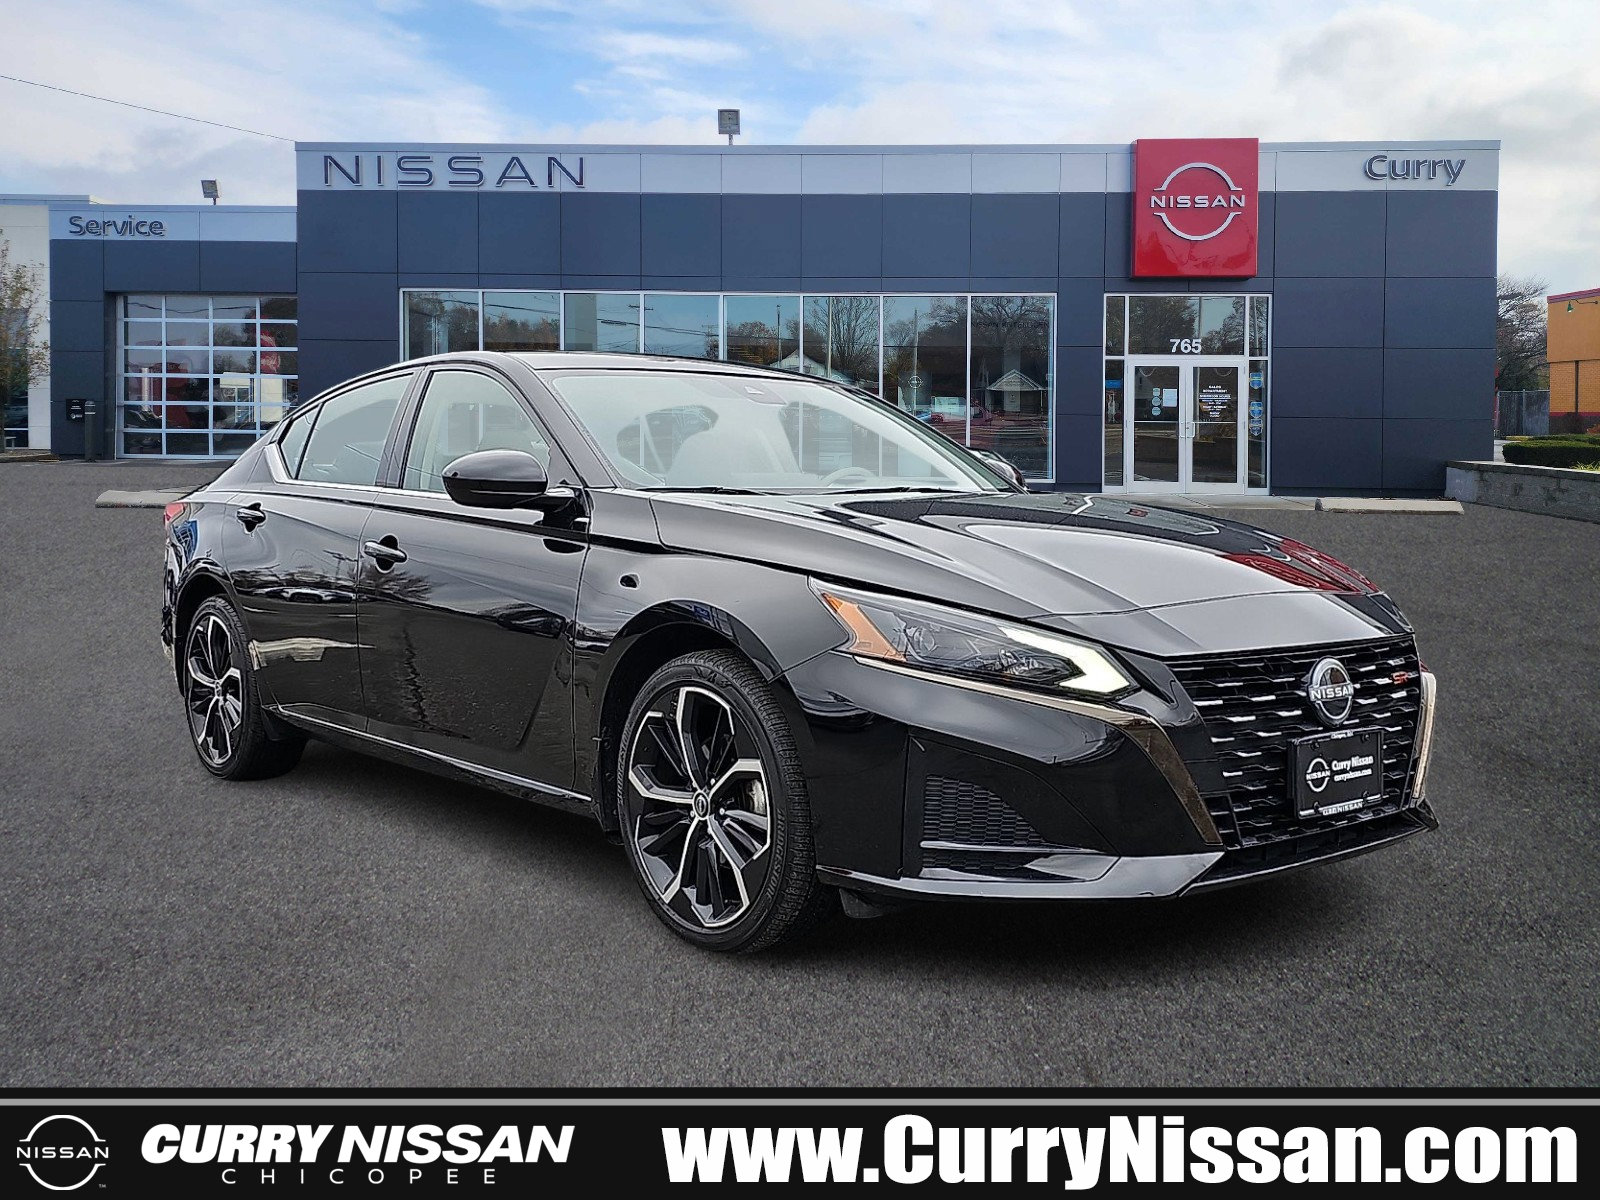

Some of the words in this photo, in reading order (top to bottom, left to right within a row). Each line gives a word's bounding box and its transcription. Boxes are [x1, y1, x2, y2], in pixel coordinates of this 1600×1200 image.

[323, 154, 586, 188] NISSAN
[1364, 154, 1466, 186] Curry
[1150, 194, 1246, 210] NISSAN
[68, 214, 166, 237] Service
[1169, 338, 1203, 353] 765
[1311, 685, 1354, 700] NISSAN
[1331, 760, 1351, 771] Curry
[1351, 755, 1374, 767] Nissan
[1305, 770, 1331, 780] NISSAN
